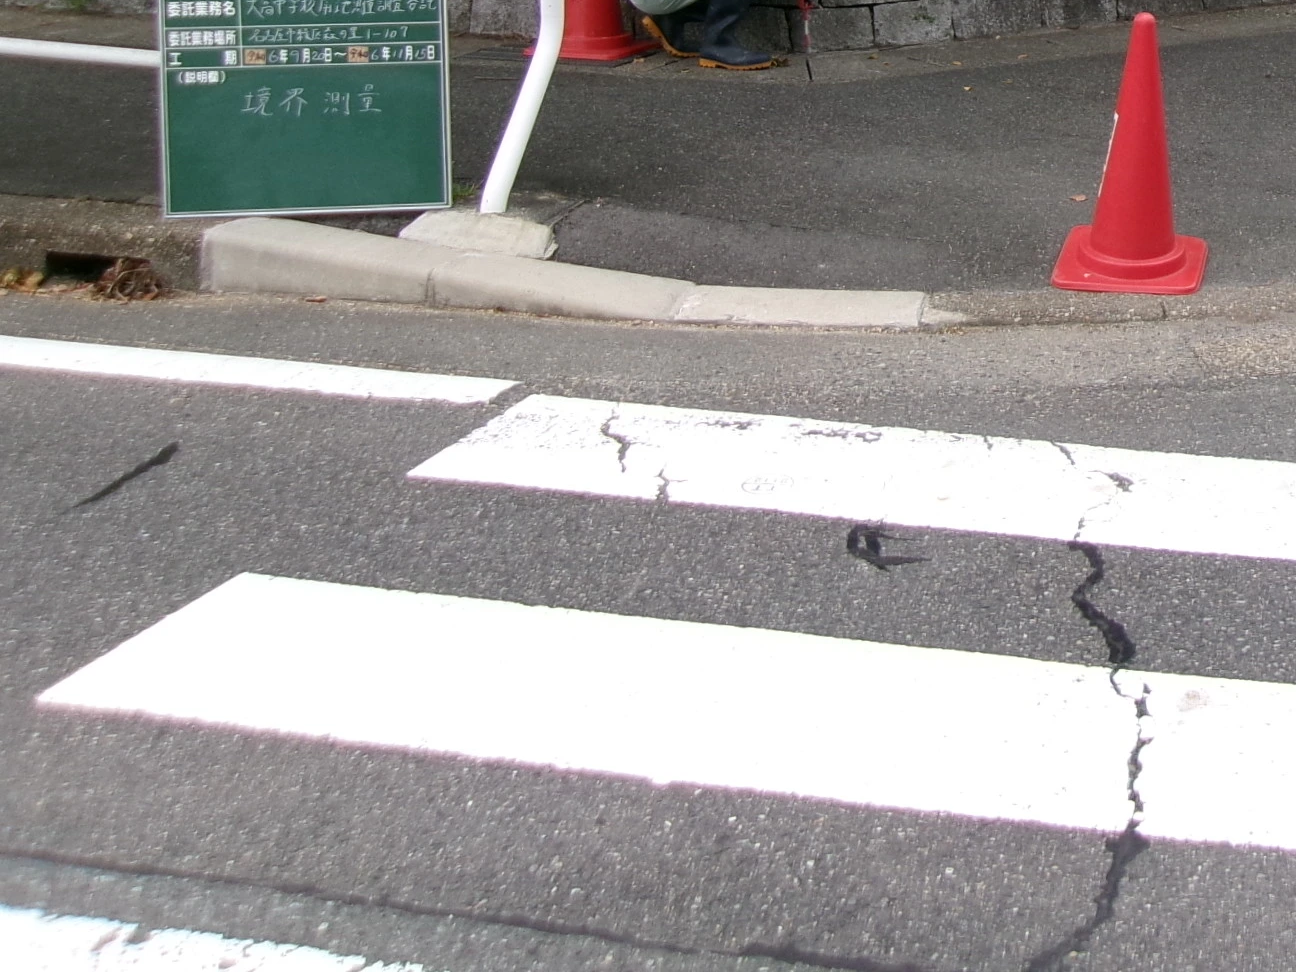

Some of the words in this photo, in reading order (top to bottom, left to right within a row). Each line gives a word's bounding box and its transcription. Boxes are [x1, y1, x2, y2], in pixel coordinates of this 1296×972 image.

[167, 0, 236, 17] 委託業務名
[168, 30, 236, 47] 委託業務場所
